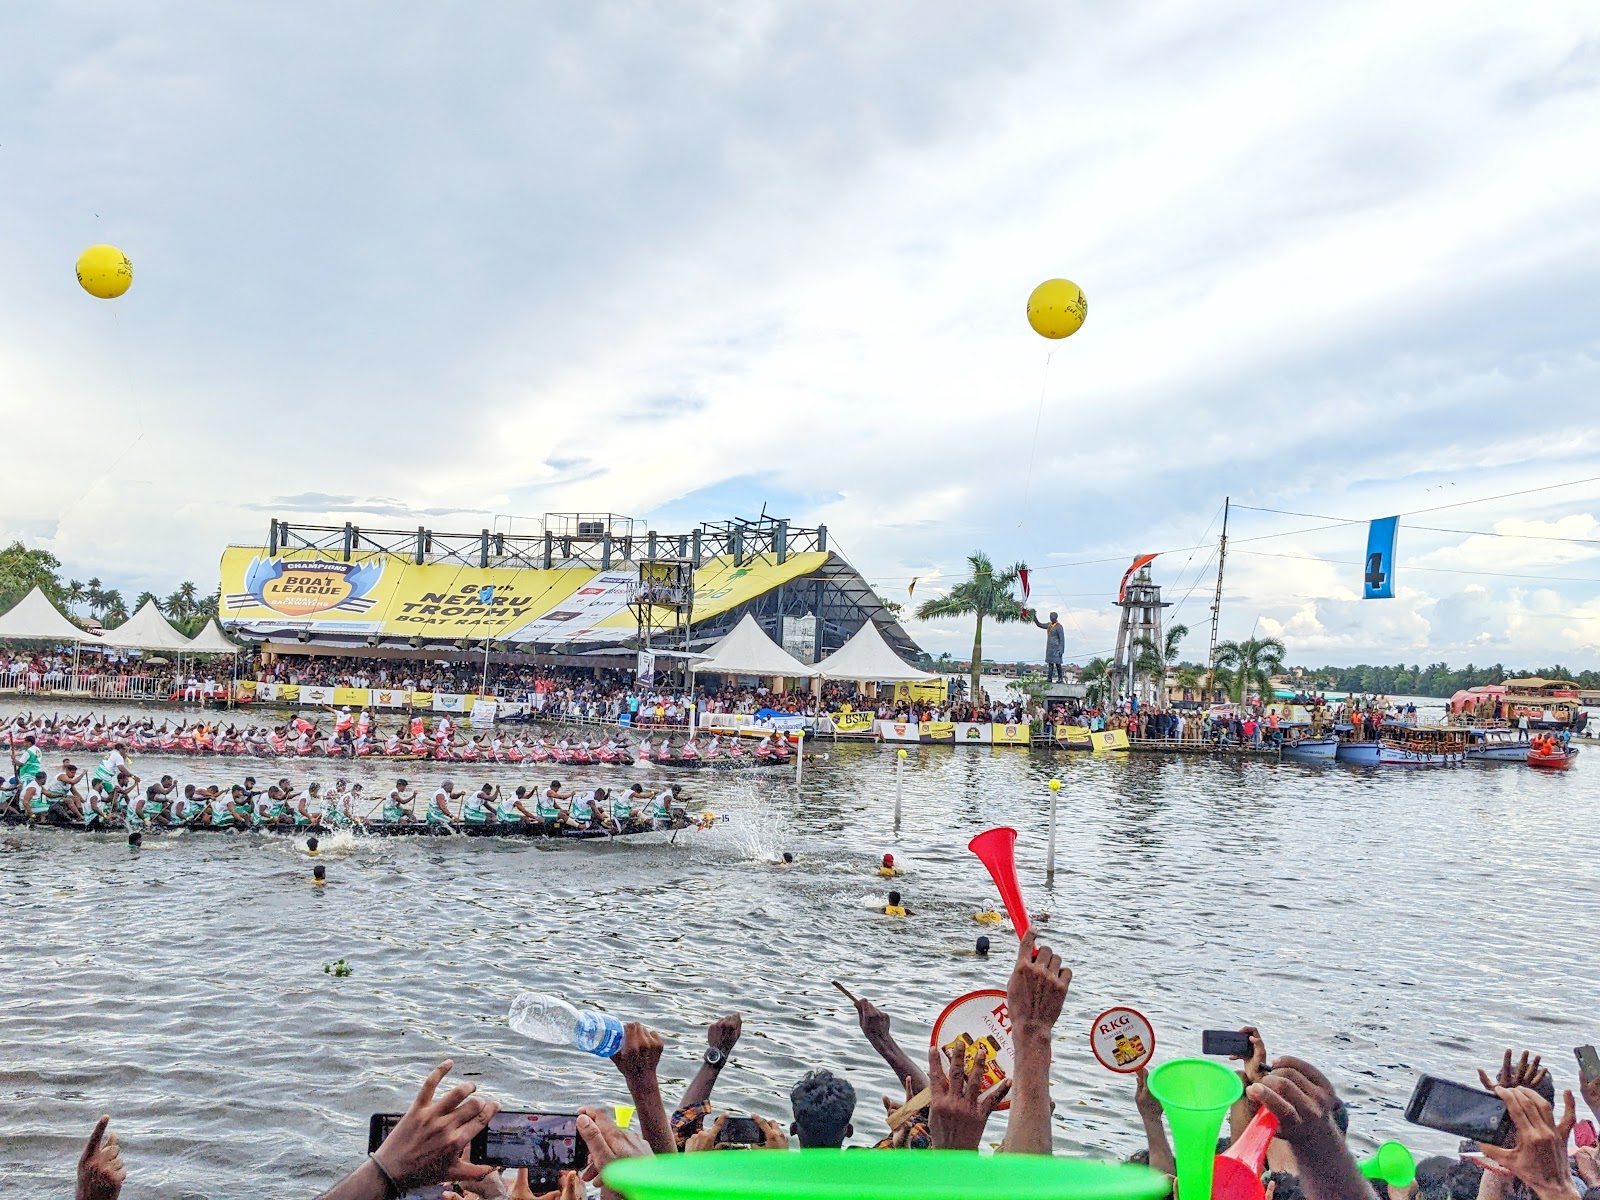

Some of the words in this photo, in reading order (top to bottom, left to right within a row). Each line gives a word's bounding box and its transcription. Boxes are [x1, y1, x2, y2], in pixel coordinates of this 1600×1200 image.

[287, 562, 347, 572] CHAMPIONS
[1365, 552, 1385, 588] 4
[286, 576, 335, 586] BOAT
[271, 585, 342, 595] LEAGUE
[420, 592, 533, 606] NEHRU
[402, 602, 533, 617] TROPHY
[395, 615, 452, 625] BOAT
[721, 814, 730, 823] 15
[1099, 1015, 1130, 1035] RKG
[981, 1014, 1009, 1049] AGMARK
